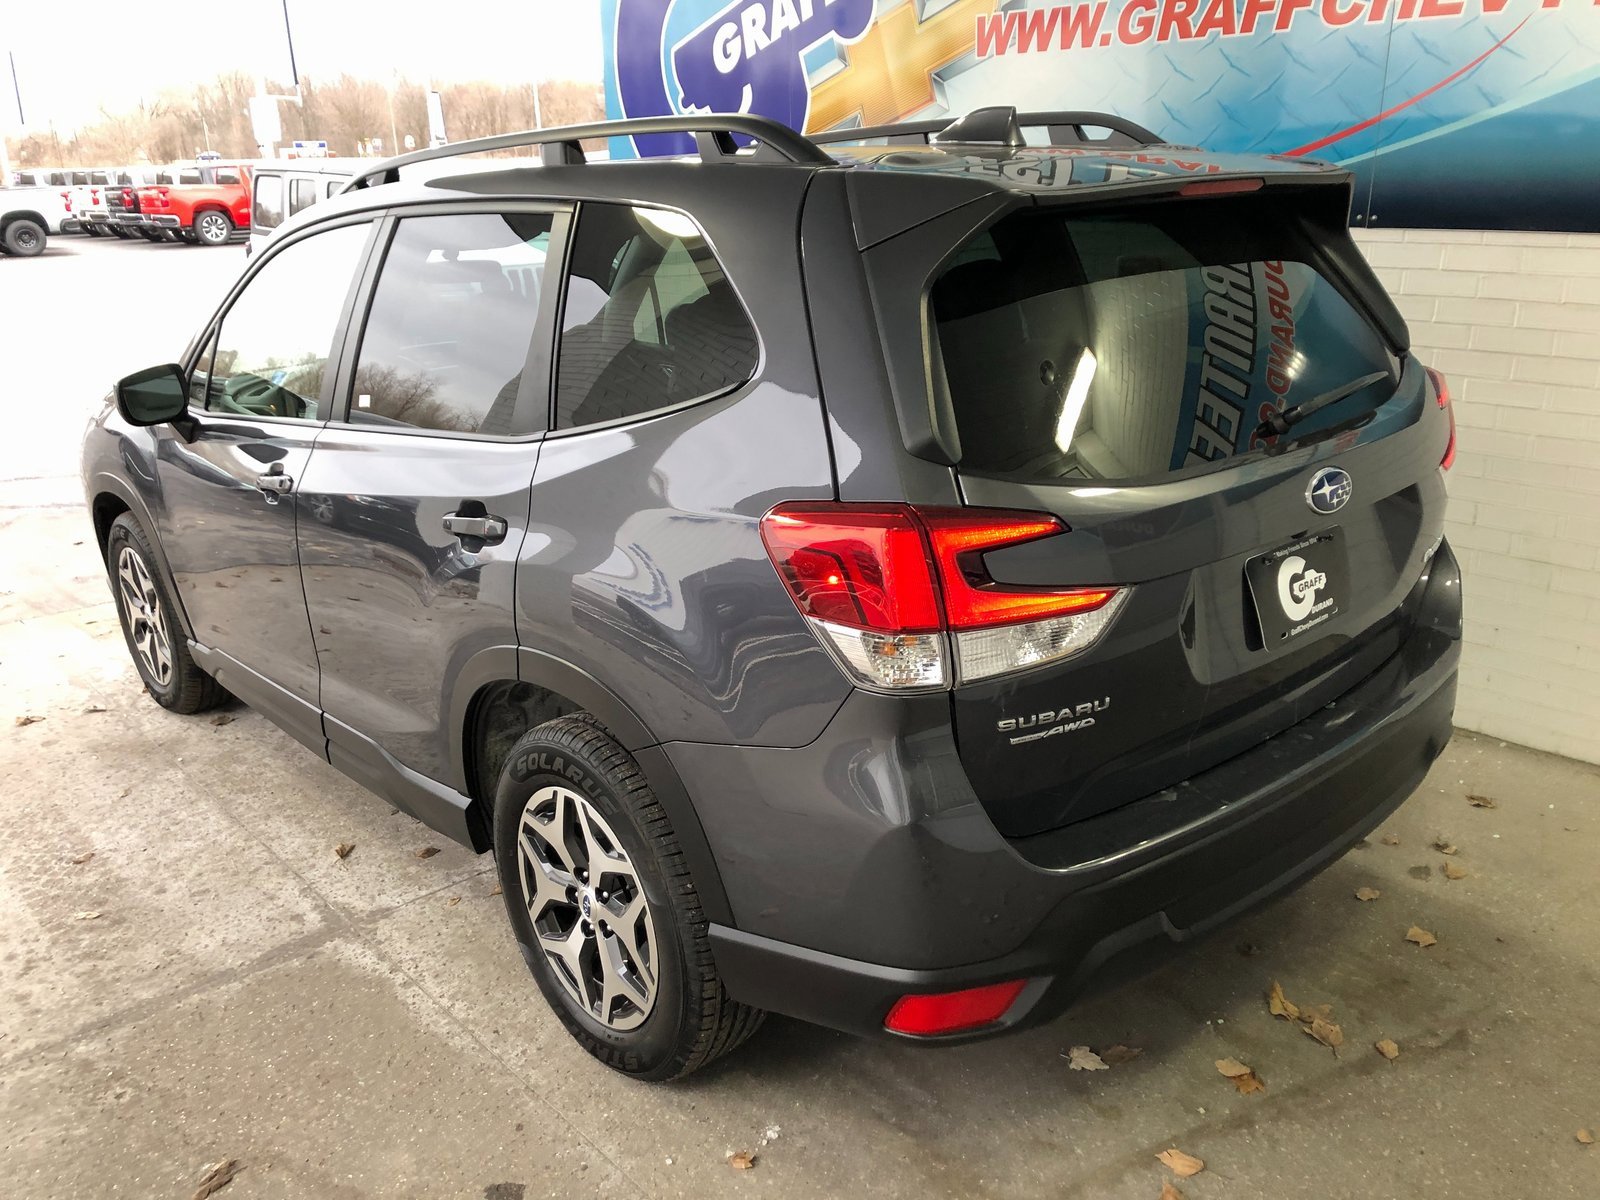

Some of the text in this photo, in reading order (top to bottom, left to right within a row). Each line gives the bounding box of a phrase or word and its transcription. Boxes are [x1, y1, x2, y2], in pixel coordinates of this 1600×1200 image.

[1298, 574, 1323, 592] GRAFF
[997, 696, 1110, 732] SUBARU
[1043, 717, 1096, 738] AWD
[516, 752, 619, 816] SOLARUS
